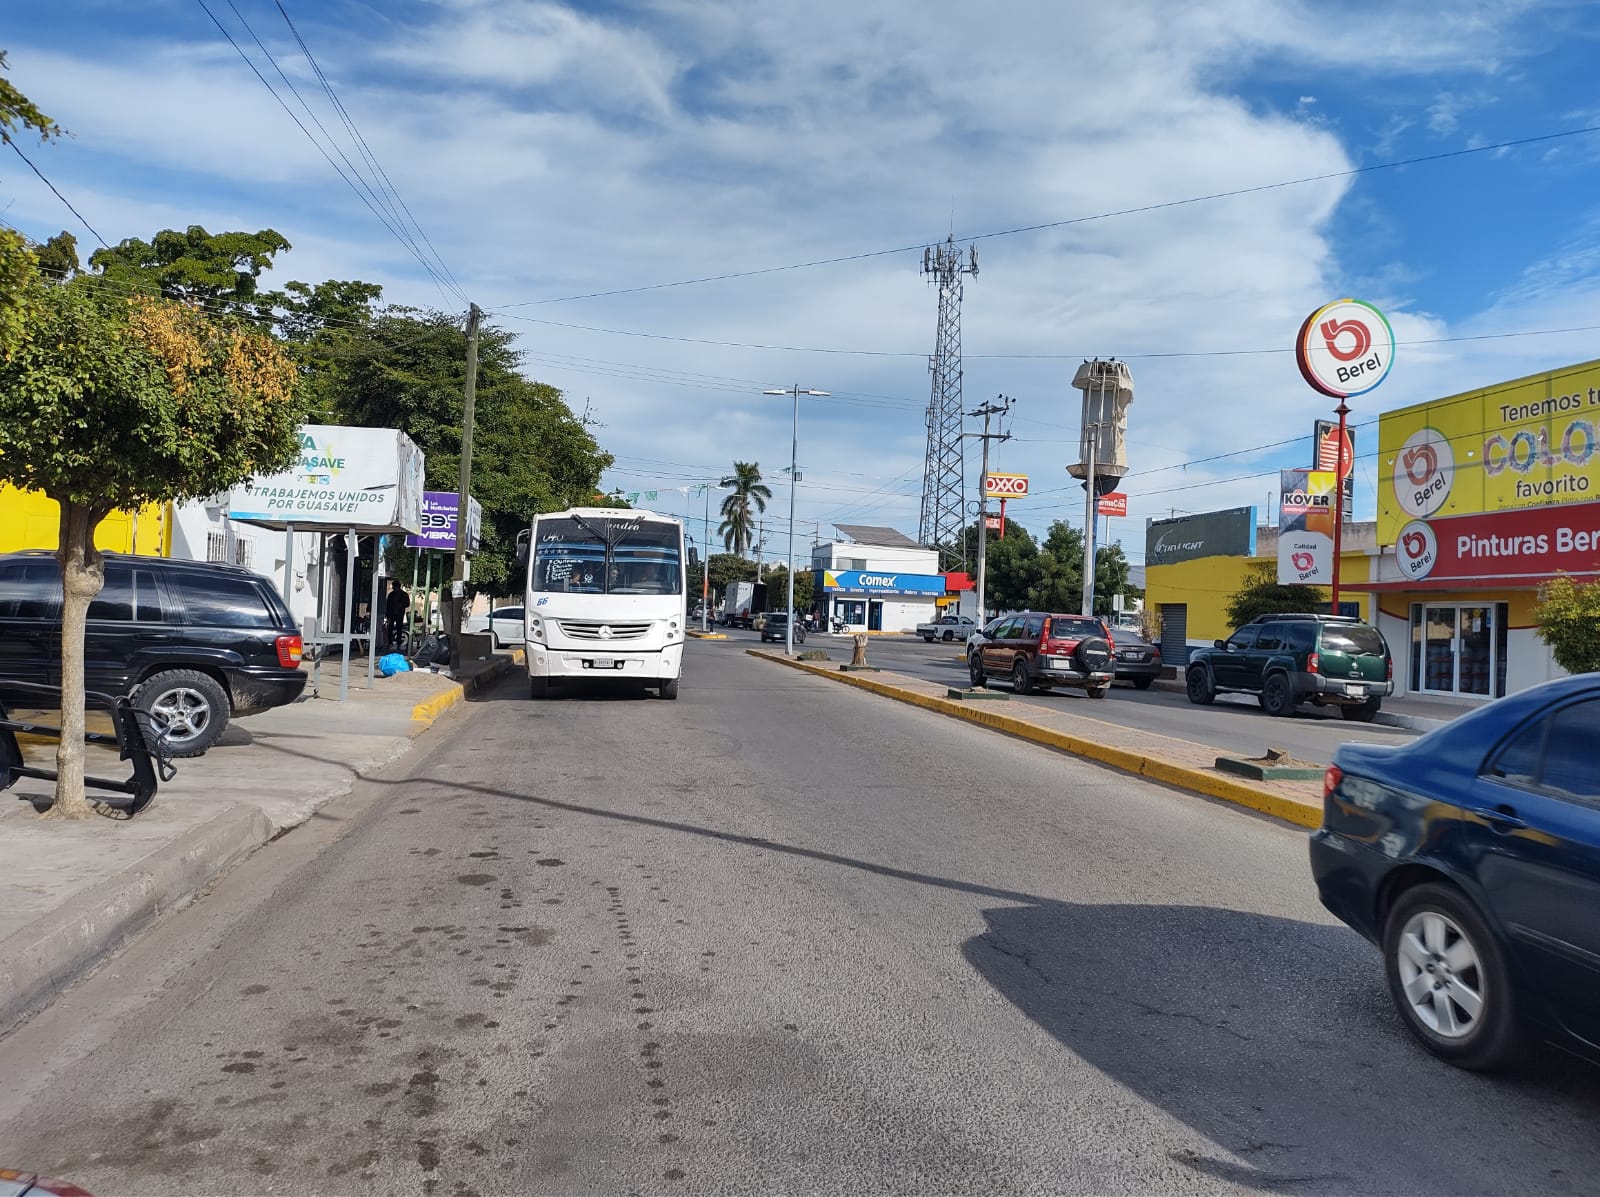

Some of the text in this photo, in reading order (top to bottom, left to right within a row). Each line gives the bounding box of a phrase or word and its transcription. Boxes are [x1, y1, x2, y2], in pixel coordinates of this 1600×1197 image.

[1336, 352, 1381, 383] Berel
[1500, 394, 1581, 422] Tenemos
[1483, 419, 1600, 476] COLO
[985, 478, 1027, 493] OXXO
[1414, 472, 1447, 507] Berel
[1515, 476, 1589, 498] favorito
[267, 498, 359, 513] POR GUASAVE!
[339, 492, 385, 503] UNIDOS
[1457, 534, 1549, 558] Pinturas
[1410, 552, 1433, 573] Berel
[859, 575, 897, 588] Comex
[1299, 567, 1319, 581] Berel
